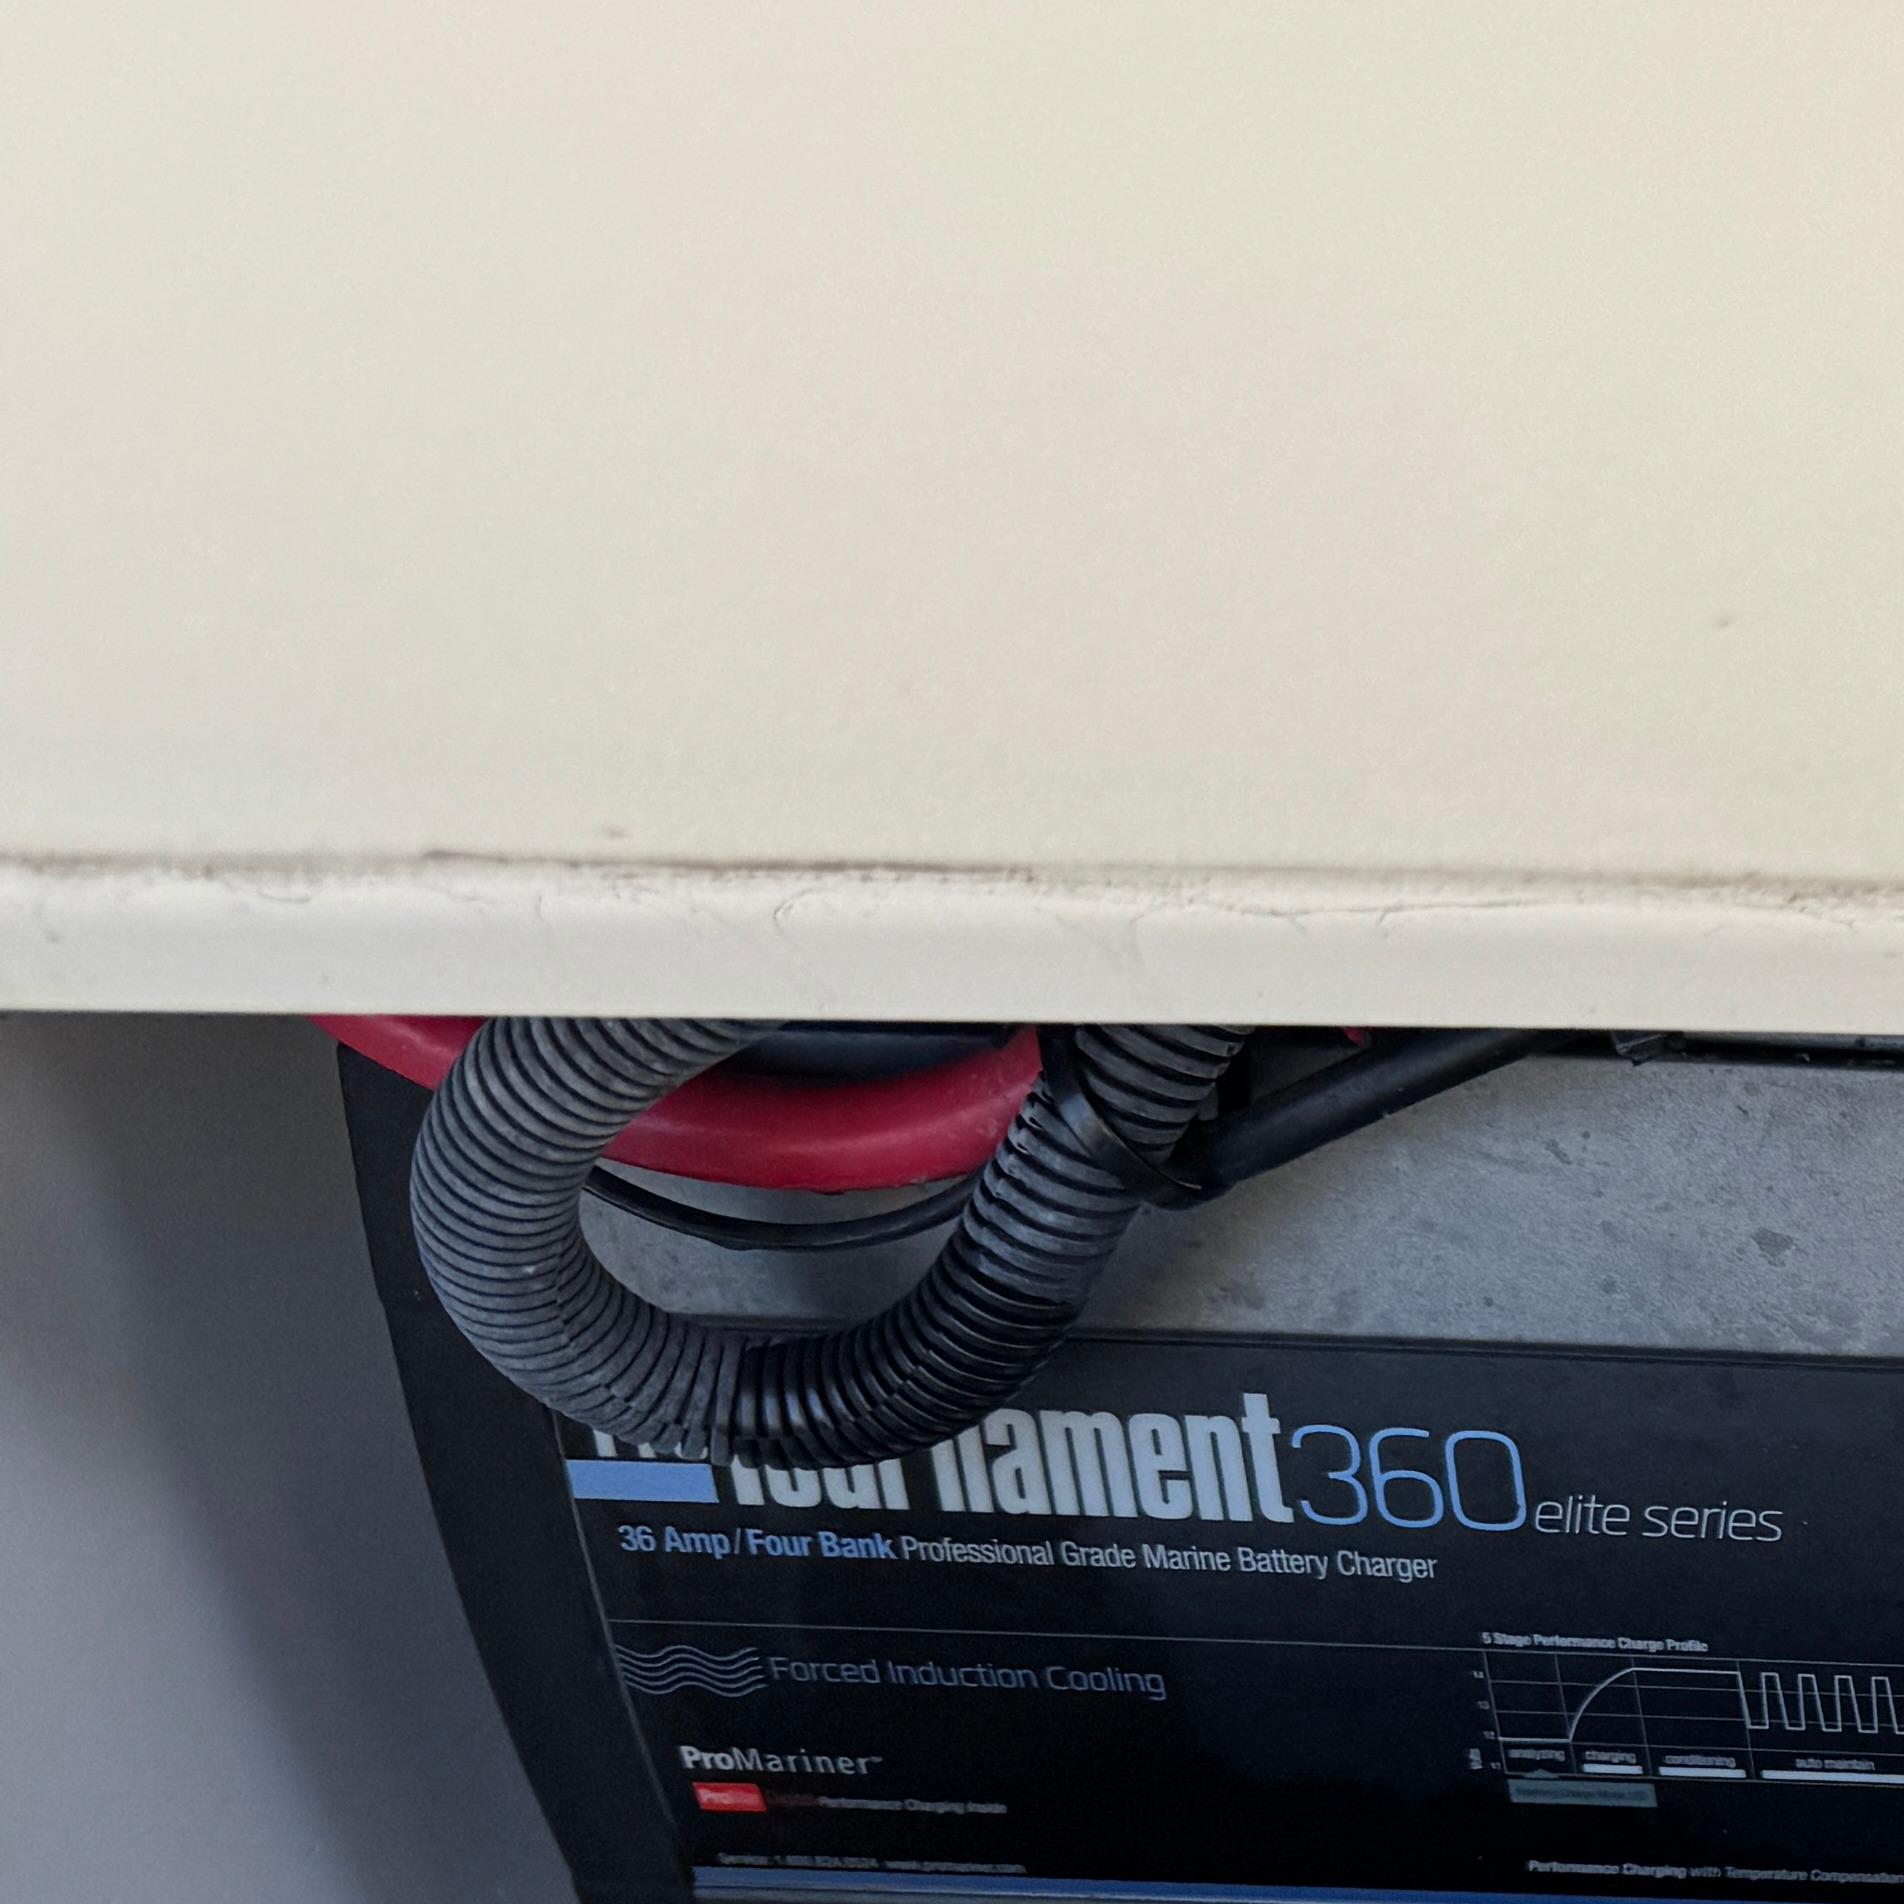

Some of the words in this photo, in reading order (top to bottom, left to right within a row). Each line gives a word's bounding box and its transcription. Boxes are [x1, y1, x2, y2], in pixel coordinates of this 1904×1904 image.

[1535, 1495, 1630, 1537] elite
[1643, 1500, 1783, 1542] series
[618, 1525, 658, 1553] 36
[818, 1531, 899, 1561] Bank
[901, 1535, 1054, 1567] Professional
[1060, 1543, 1136, 1570] Grade
[1144, 1546, 1232, 1572] Marine
[1238, 1548, 1329, 1579] Battery
[1336, 1549, 1438, 1582] Charger
[1481, 1631, 1492, 1645] 5
[1493, 1632, 1532, 1648] Stage
[1533, 1633, 1617, 1650] Performance
[1617, 1636, 1664, 1653] Charge
[1665, 1637, 1710, 1653] Profile
[770, 1656, 881, 1685] Forced
[888, 1658, 1038, 1691] Induction
[1046, 1664, 1168, 1701] Cooling
